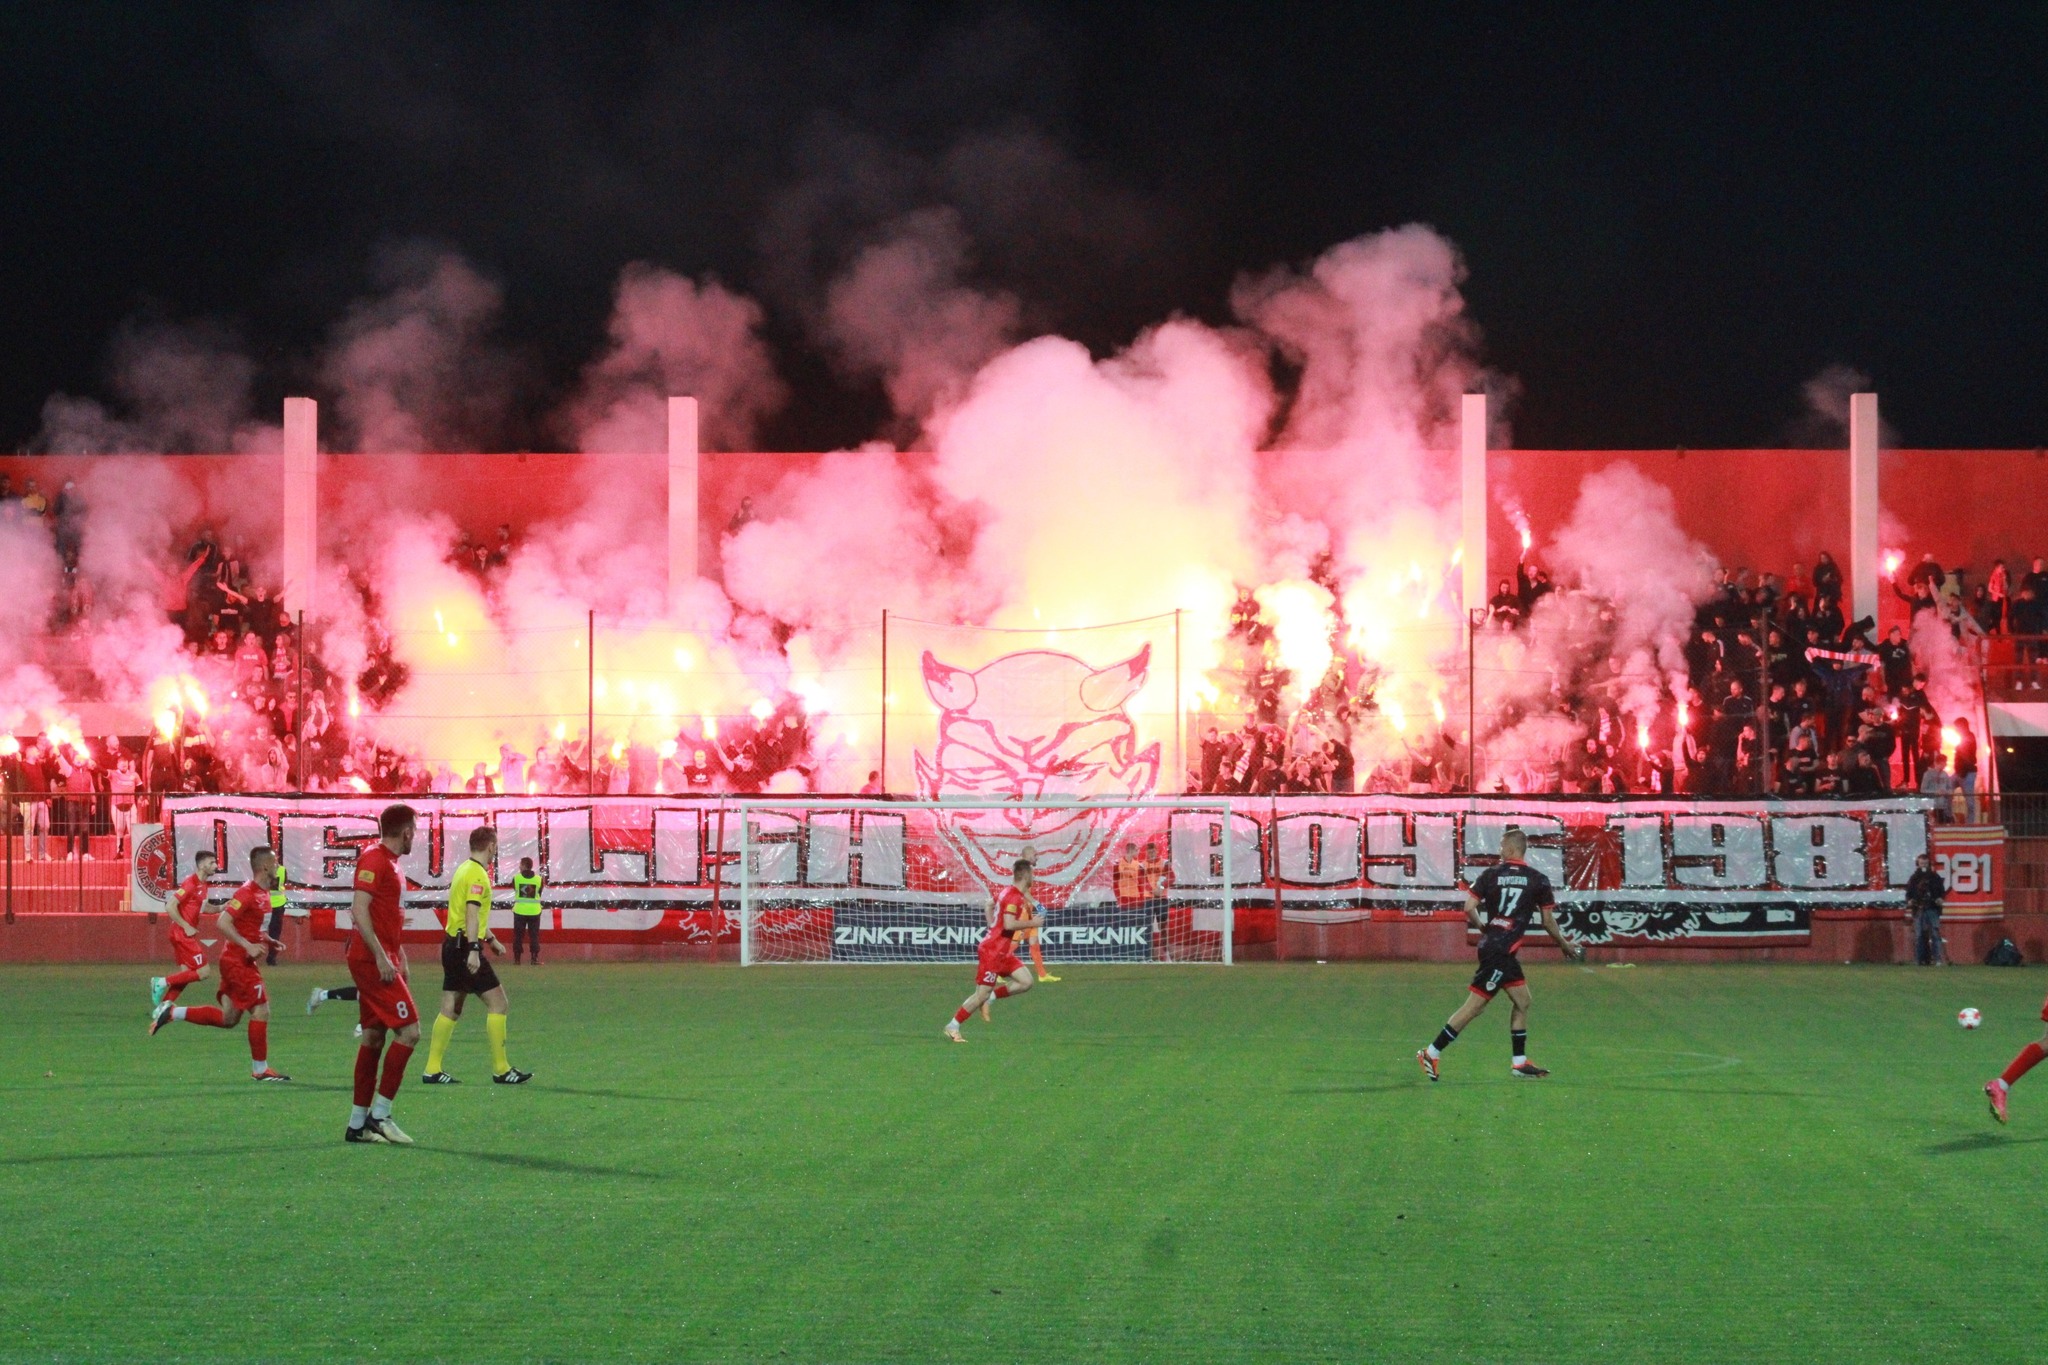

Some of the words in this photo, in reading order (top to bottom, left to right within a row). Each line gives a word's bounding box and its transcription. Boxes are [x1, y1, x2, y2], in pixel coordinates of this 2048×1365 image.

[139, 834, 166, 863] AGRE
[1168, 810, 1566, 891] BOYS
[1606, 809, 1932, 889] 1981
[1935, 853, 1992, 892] 981
[1498, 887, 1524, 917] 17
[834, 926, 988, 945] ZINKTEKNIK
[1020, 926, 1149, 945] KTEKNIK
[192, 953, 204, 966] 17
[983, 970, 997, 984] 28
[1490, 969, 1504, 983] 17
[396, 1000, 409, 1019] 8
